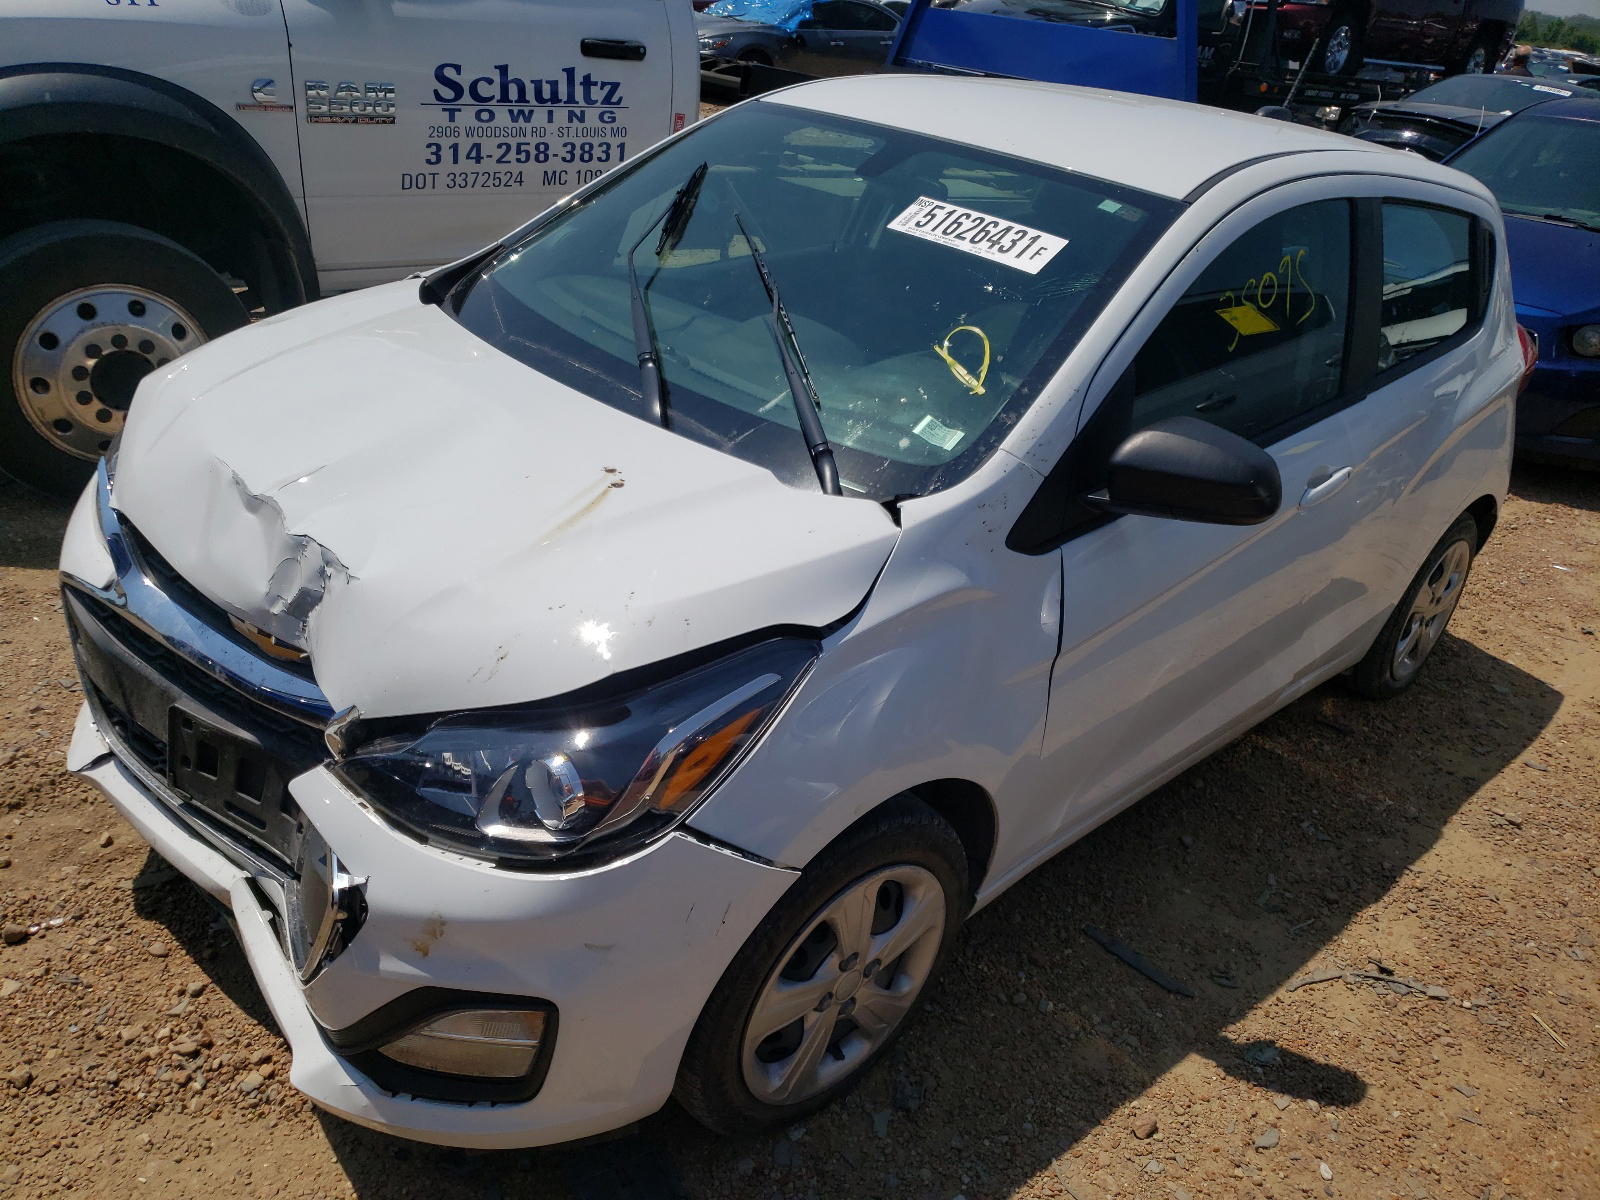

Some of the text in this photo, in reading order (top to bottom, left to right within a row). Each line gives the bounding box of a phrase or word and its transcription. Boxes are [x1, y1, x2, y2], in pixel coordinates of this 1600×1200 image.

[305, 80, 395, 99] RAM
[433, 62, 624, 106] Schultz
[306, 98, 396, 114] 5500
[441, 107, 618, 124] TOWING
[428, 125, 460, 138] 2906
[464, 126, 527, 138] WOODSON
[531, 126, 547, 138] RD
[610, 126, 628, 138] MO
[425, 141, 626, 165] 314-258-3831
[401, 173, 439, 190] DOT
[446, 170, 525, 189] 3372524
[542, 170, 568, 186] MC
[914, 204, 1042, 260] 51626431
